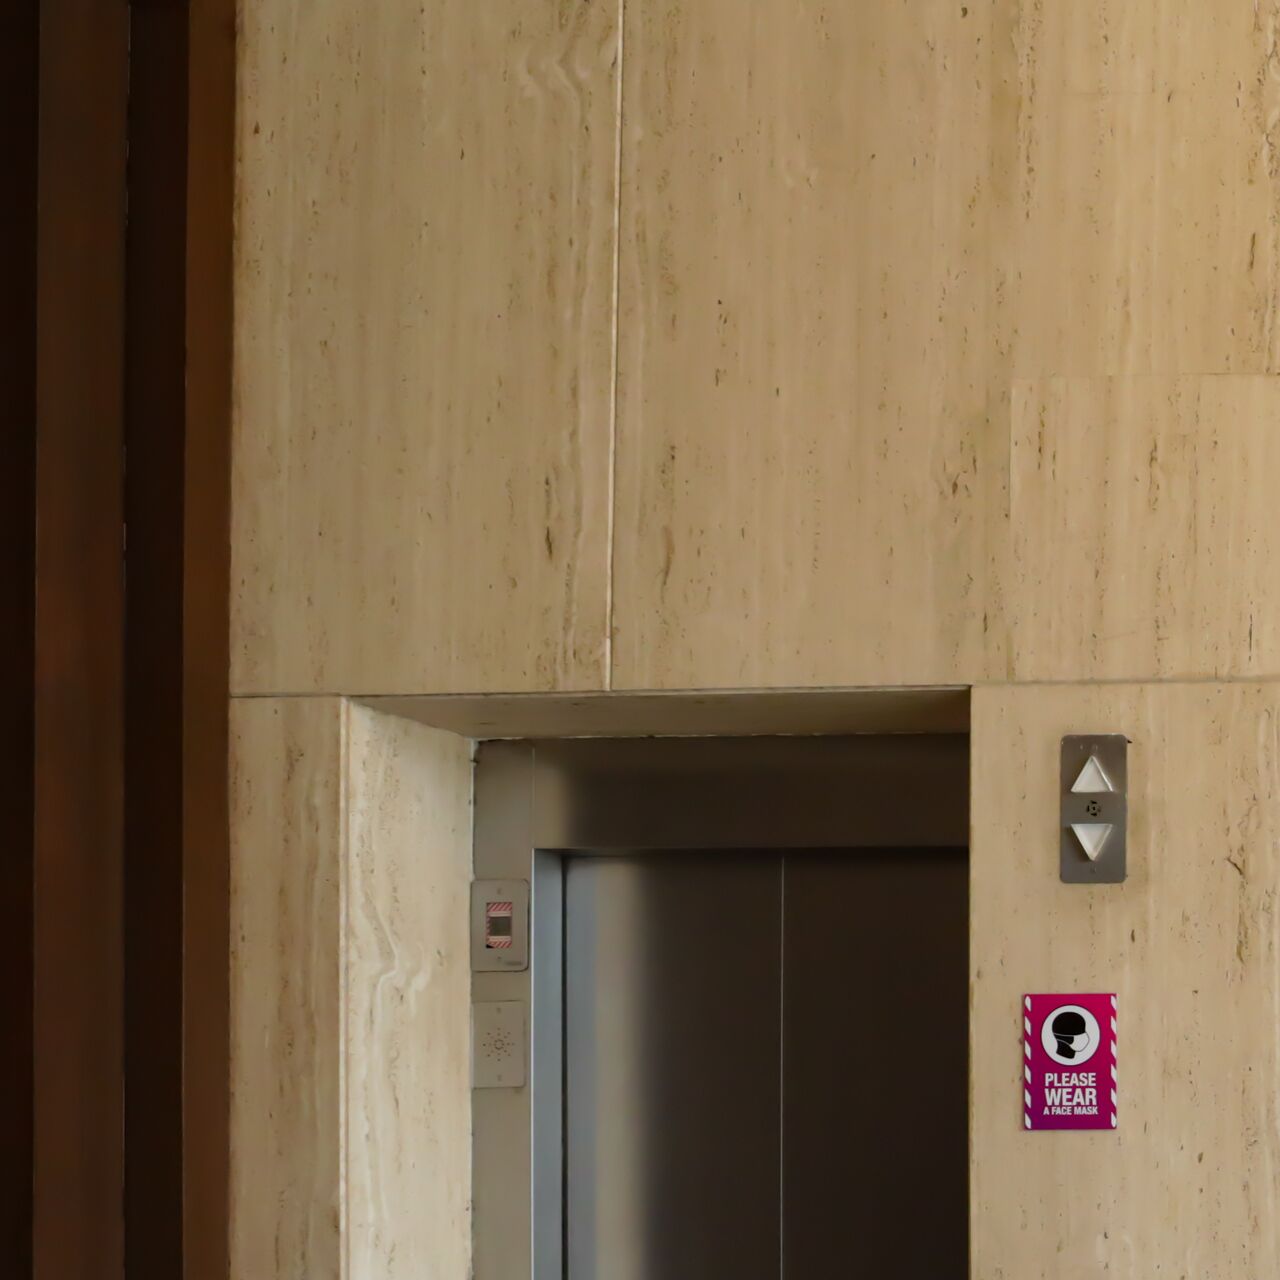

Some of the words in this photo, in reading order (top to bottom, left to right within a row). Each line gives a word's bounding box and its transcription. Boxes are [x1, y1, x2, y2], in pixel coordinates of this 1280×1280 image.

[1044, 1072, 1097, 1087] PLEASE
[1044, 1088, 1098, 1106] WEAR
[1043, 1106, 1050, 1115] A
[1051, 1106, 1072, 1115] FACE
[1073, 1106, 1098, 1115] MASK
